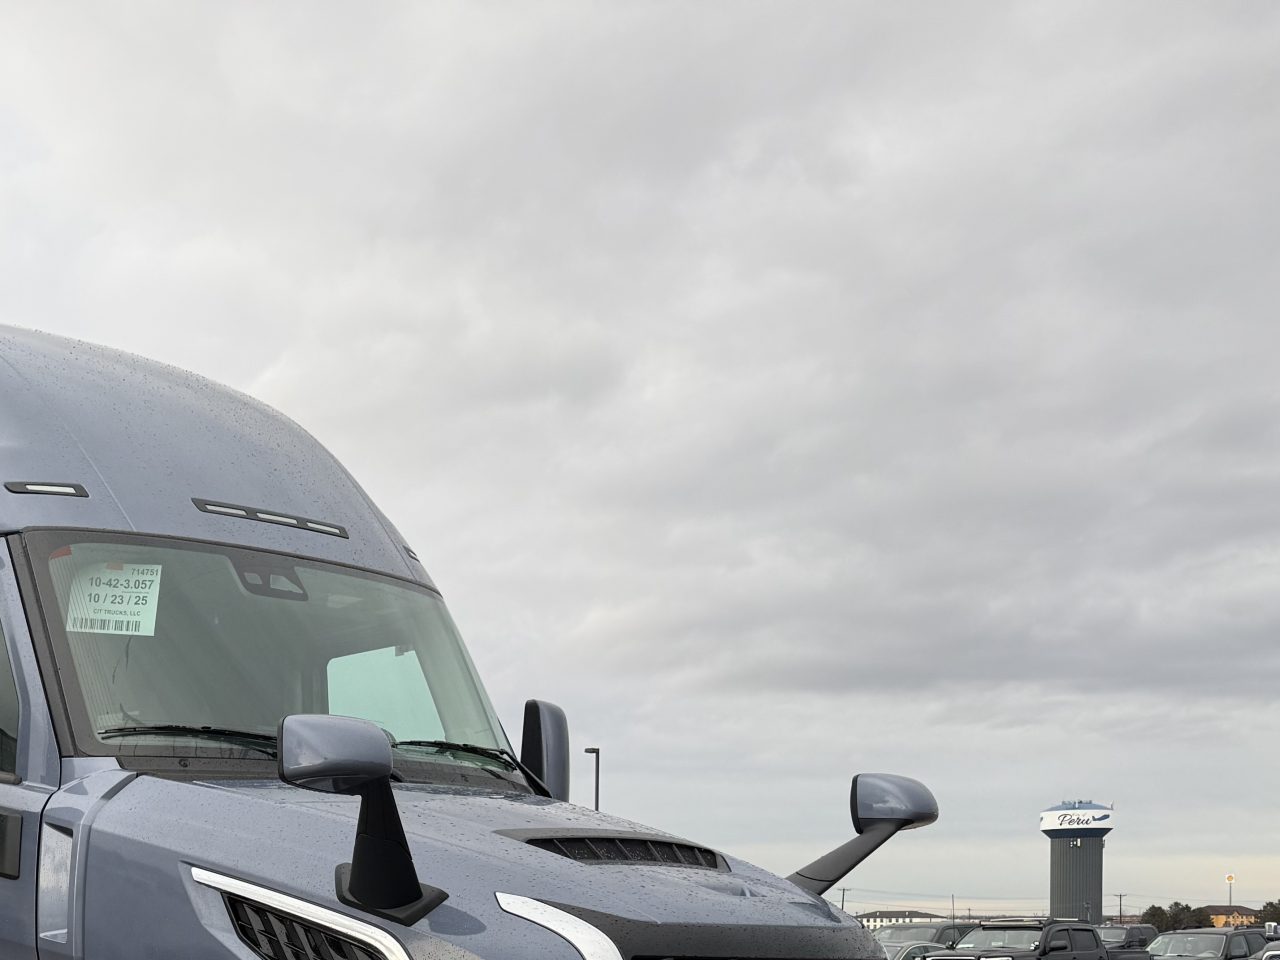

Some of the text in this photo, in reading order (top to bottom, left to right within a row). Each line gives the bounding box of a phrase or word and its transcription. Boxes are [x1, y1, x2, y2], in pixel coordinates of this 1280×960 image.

[131, 568, 159, 576] 714751
[89, 576, 154, 590] 10-42-3.057
[88, 593, 100, 603] 10
[110, 594, 124, 605] 23
[134, 595, 148, 606] 25
[1057, 813, 1092, 827] Peru
